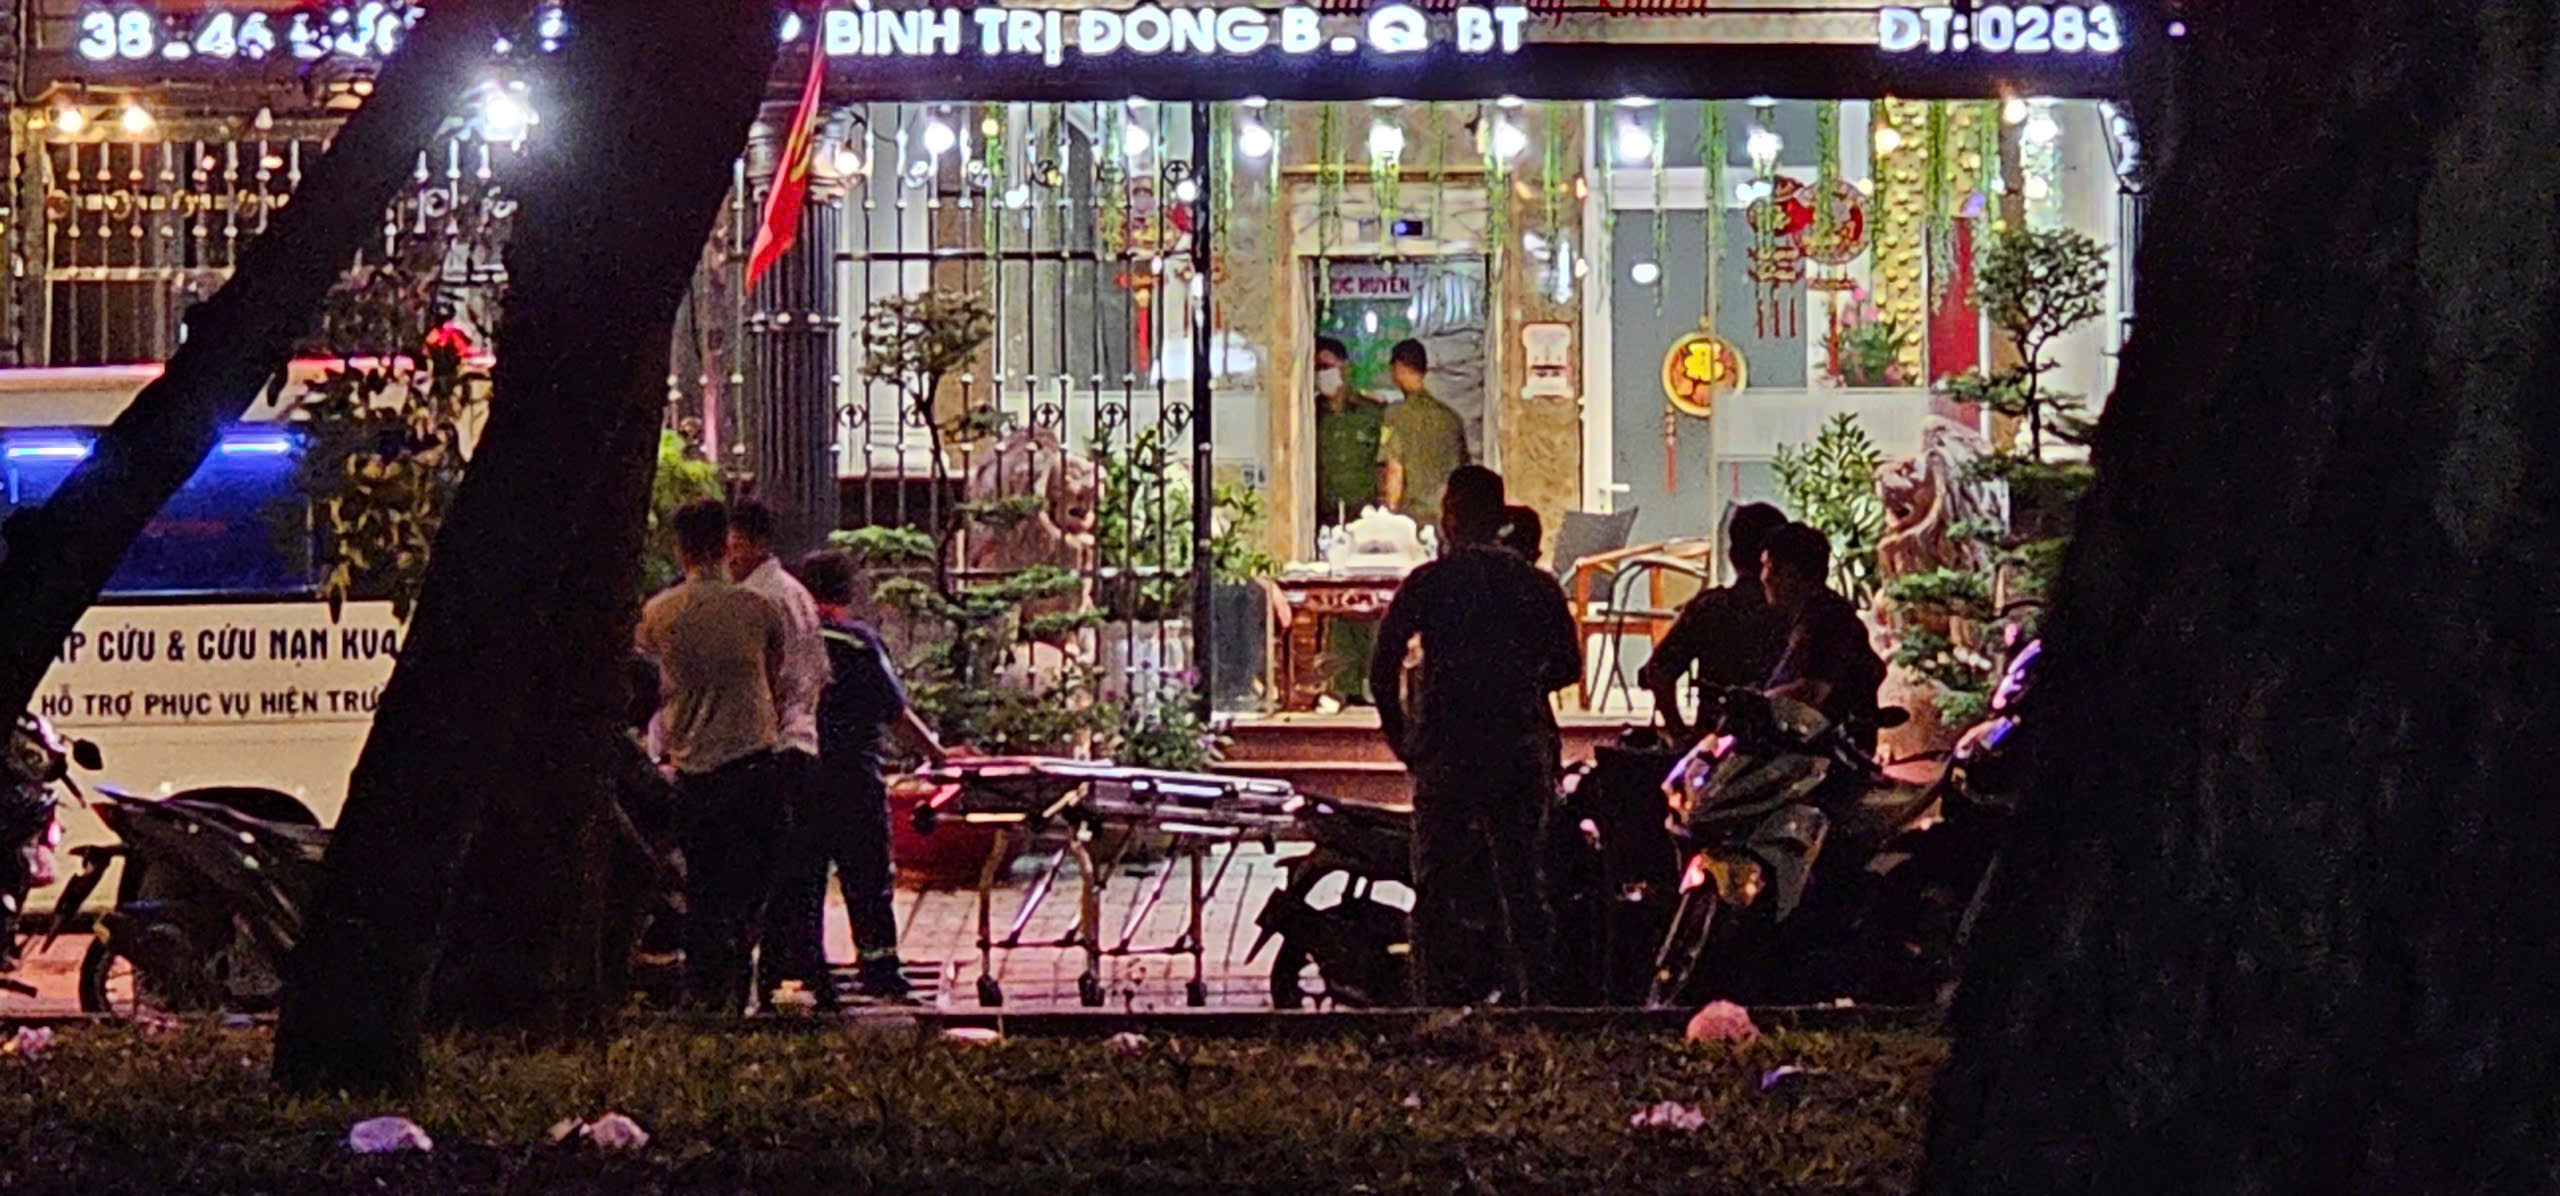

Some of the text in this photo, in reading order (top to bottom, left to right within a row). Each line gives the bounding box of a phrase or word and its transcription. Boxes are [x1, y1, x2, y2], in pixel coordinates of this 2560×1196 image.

[80, 11, 153, 58] 38
[826, 0, 960, 55] BÌNH
[975, 9, 1062, 66] TRỊ
[1079, 4, 1270, 53] ĐÔNG
[1282, 7, 1321, 52] B
[1457, 7, 1528, 53] BT
[98, 624, 155, 662] CỨU
[168, 629, 186, 661] &
[197, 624, 256, 662] CỨU
[269, 628, 328, 668] NẠN
[84, 691, 134, 720] TRỢ
[144, 693, 212, 723] PHỤC
[219, 691, 251, 721] VỤ
[261, 686, 318, 718] HIỆN
